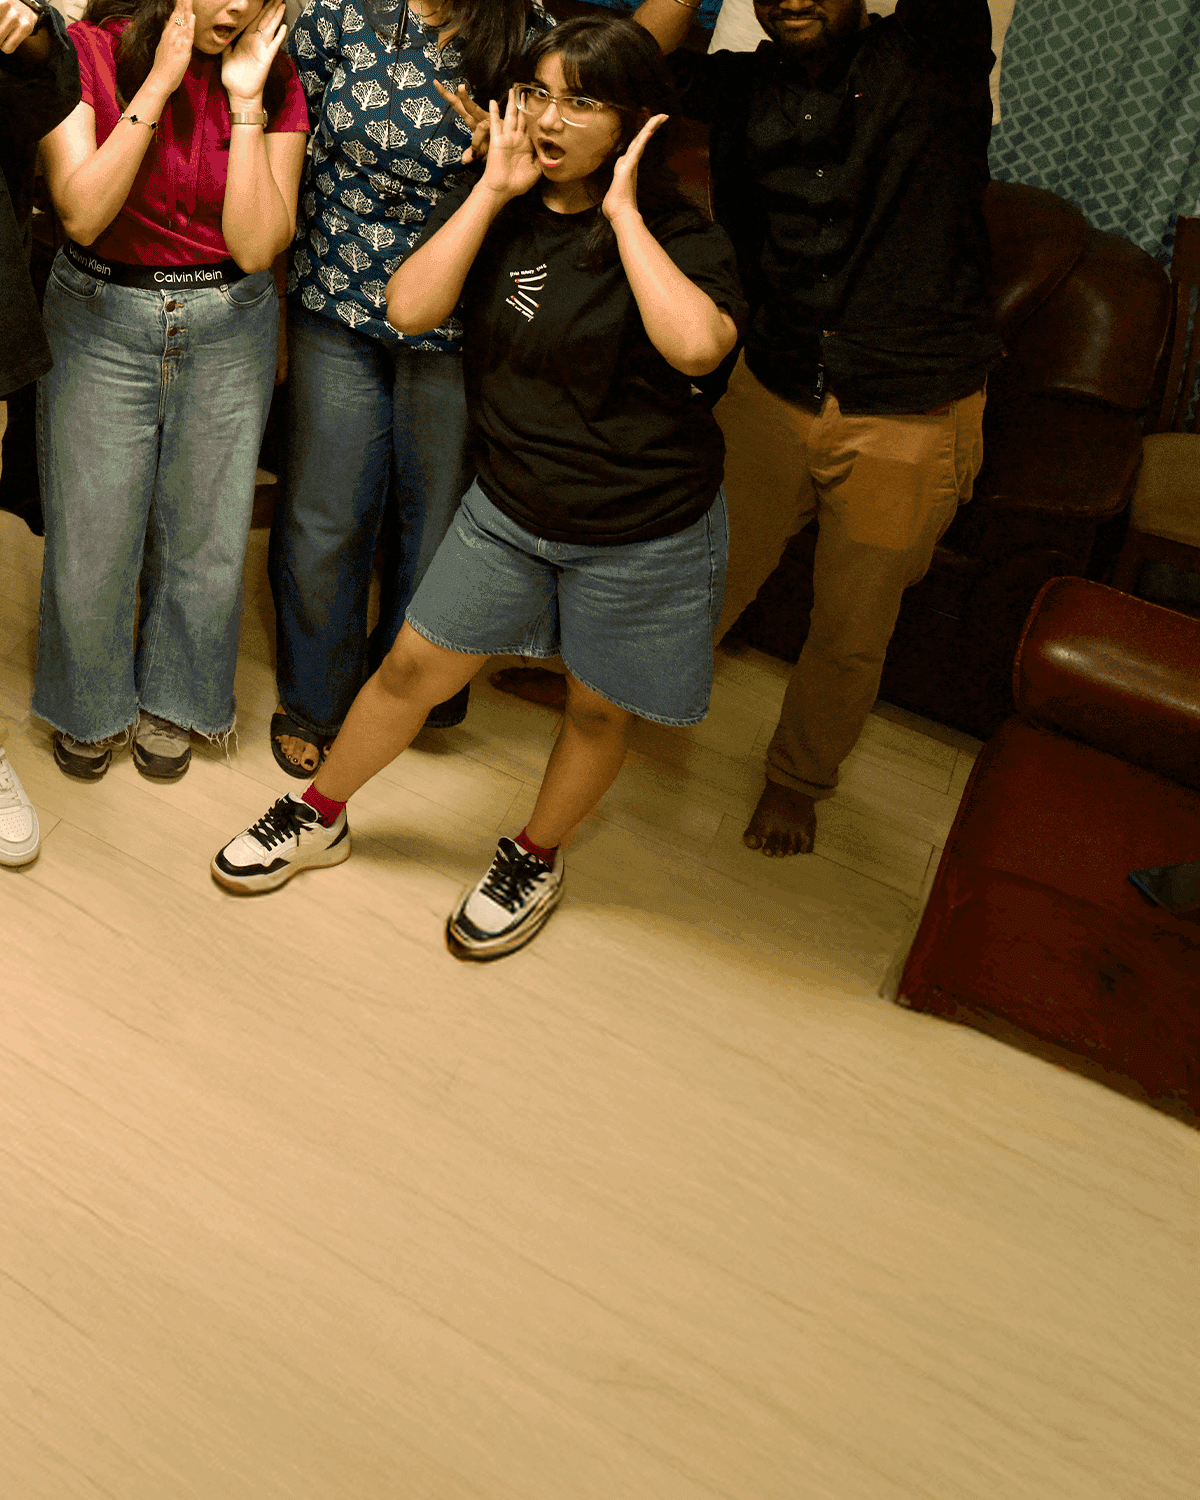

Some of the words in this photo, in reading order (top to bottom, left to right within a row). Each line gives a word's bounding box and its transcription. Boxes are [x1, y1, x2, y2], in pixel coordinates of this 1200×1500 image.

[88, 256, 112, 277] Klein
[153, 271, 193, 283] Calvin
[195, 269, 223, 282] Klein
